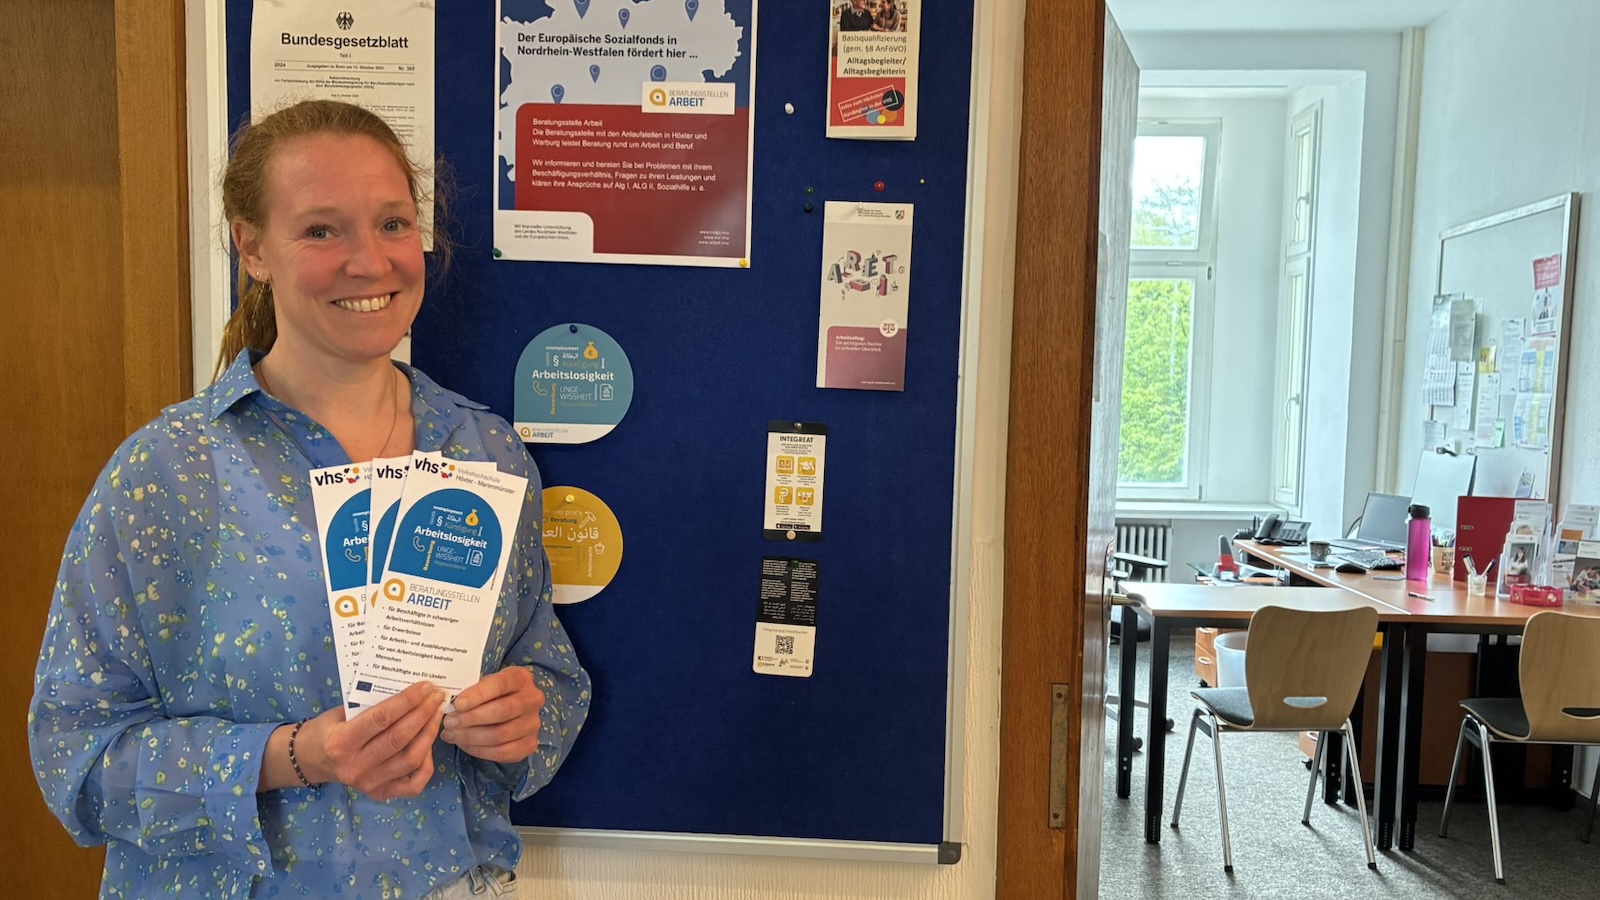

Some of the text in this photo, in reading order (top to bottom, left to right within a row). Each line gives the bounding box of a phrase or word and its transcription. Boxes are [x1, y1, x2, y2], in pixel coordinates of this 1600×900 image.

[281, 32, 409, 49] Bundesgesetzblatt
[518, 32, 677, 45] Der Europäische Sozialfonds in
[842, 34, 907, 43] Basisqualifizierung
[518, 46, 624, 57] Nordrhein-Westfalen
[627, 48, 664, 58] fördert
[666, 48, 686, 58] hier
[843, 45, 863, 54] (gem.
[847, 57, 907, 66] Alltagsbegleiter/
[843, 68, 906, 76] Alltagsbegleiterin
[668, 90, 728, 98] BERATUNGSSTELLEN
[668, 98, 705, 107] ARBEIT
[532, 118, 582, 127] Beratungsstelle
[545, 128, 594, 138] Beratungsstelle
[532, 139, 560, 148] Warburg
[582, 140, 612, 149] Beratung
[532, 169, 613, 178] Beschäftigungsverhältnis,
[614, 171, 638, 180] Fragen
[666, 174, 702, 182] Leistungen
[567, 180, 601, 189] Ansprüche
[614, 182, 626, 190] Alg
[532, 369, 614, 382] Arbeitslosigkeit
[415, 458, 439, 474] vhs
[314, 471, 344, 486] vhs
[376, 465, 403, 480] vhs
[458, 468, 500, 484] Volkshochschule
[456, 475, 515, 494] Höxter Marienmünster
[444, 521, 477, 536] Kündigung
[567, 527, 599, 542] قانون
[414, 525, 488, 548] Arbeitslosigkeit
[437, 546, 457, 554] UNGE-
[435, 552, 464, 563] WISSHEIT
[410, 583, 481, 604] BERATUNGSSTELLEN
[406, 593, 452, 610] ARBEIT
[386, 614, 435, 628] Arbeitsverhältnissen
[396, 607, 426, 618] Beschäftigte
[432, 614, 459, 624] schwierigen
[391, 626, 421, 636] Erwerbslose
[389, 636, 410, 645] Arbeits-
[375, 654, 401, 662] Menschen
[396, 648, 433, 660] Arbeitslosigkeit
[381, 665, 411, 676] Beschäftigte
[421, 671, 447, 680] EU-Ländern
